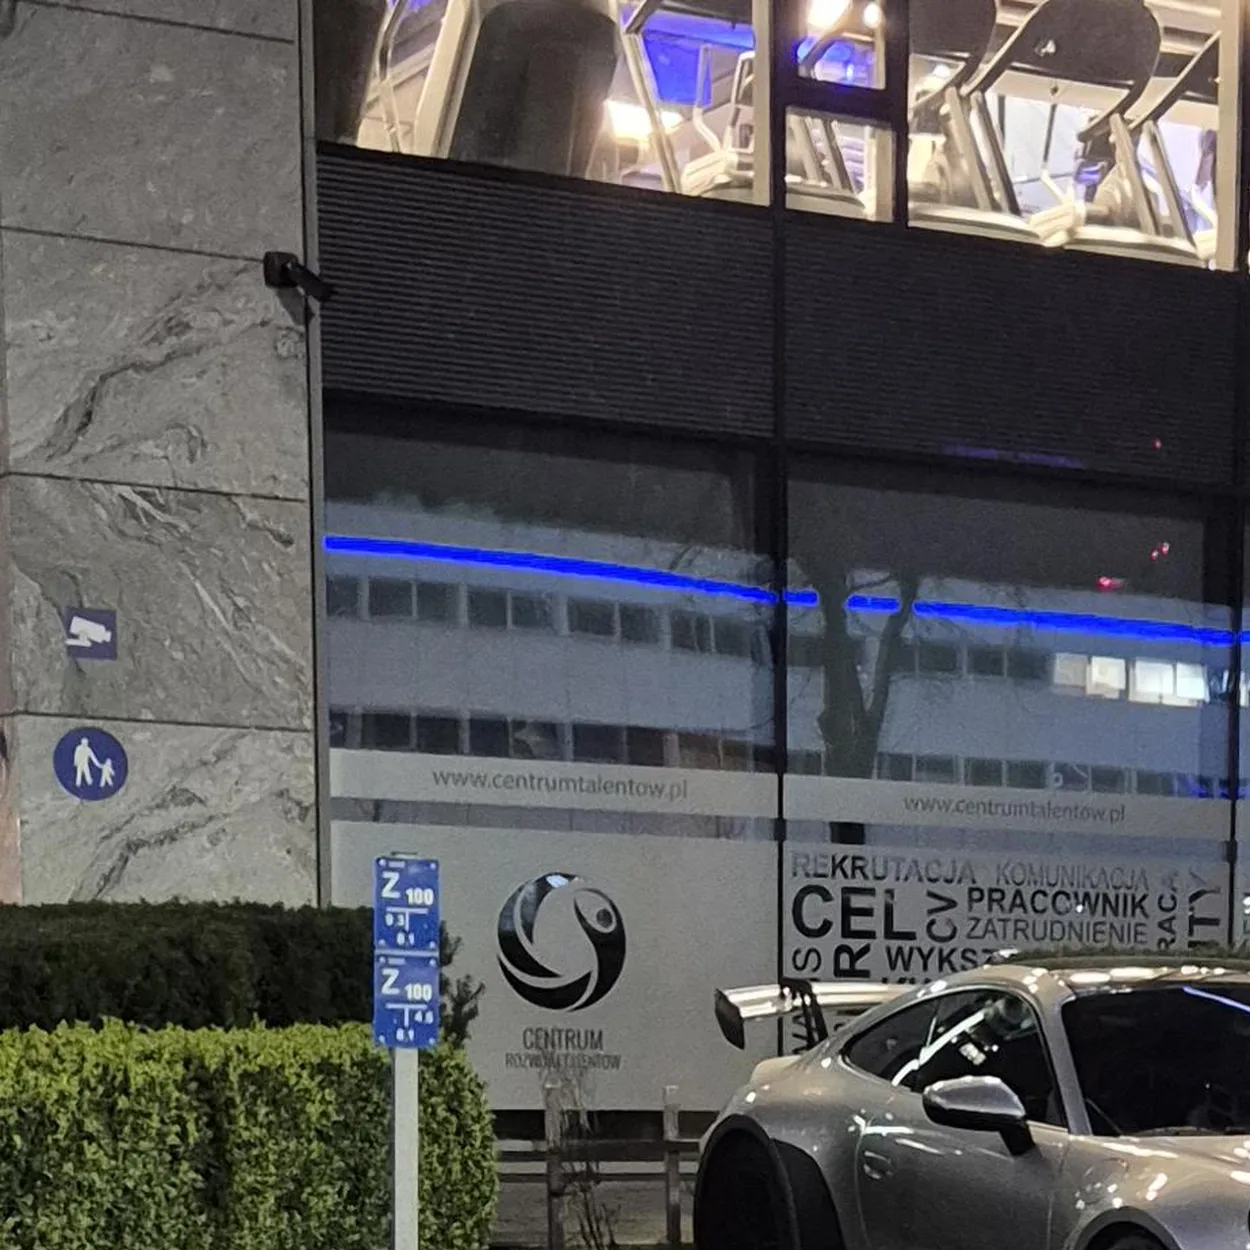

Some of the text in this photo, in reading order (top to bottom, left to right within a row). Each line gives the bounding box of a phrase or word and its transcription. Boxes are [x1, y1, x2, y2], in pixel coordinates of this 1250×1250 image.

[432, 769, 688, 800] www.centrumtalentow.pl
[381, 871, 434, 906] Z 100
[791, 852, 1149, 891] REKRUTACJA KOMUNIKACJA
[792, 884, 917, 941] CEL
[926, 889, 958, 943] CV
[967, 886, 1150, 919] PRACOWNIK
[966, 916, 1148, 945] ZATRUDNIENIE
[381, 968, 433, 1003] Z 100
[522, 1027, 604, 1051] CENTRUM
